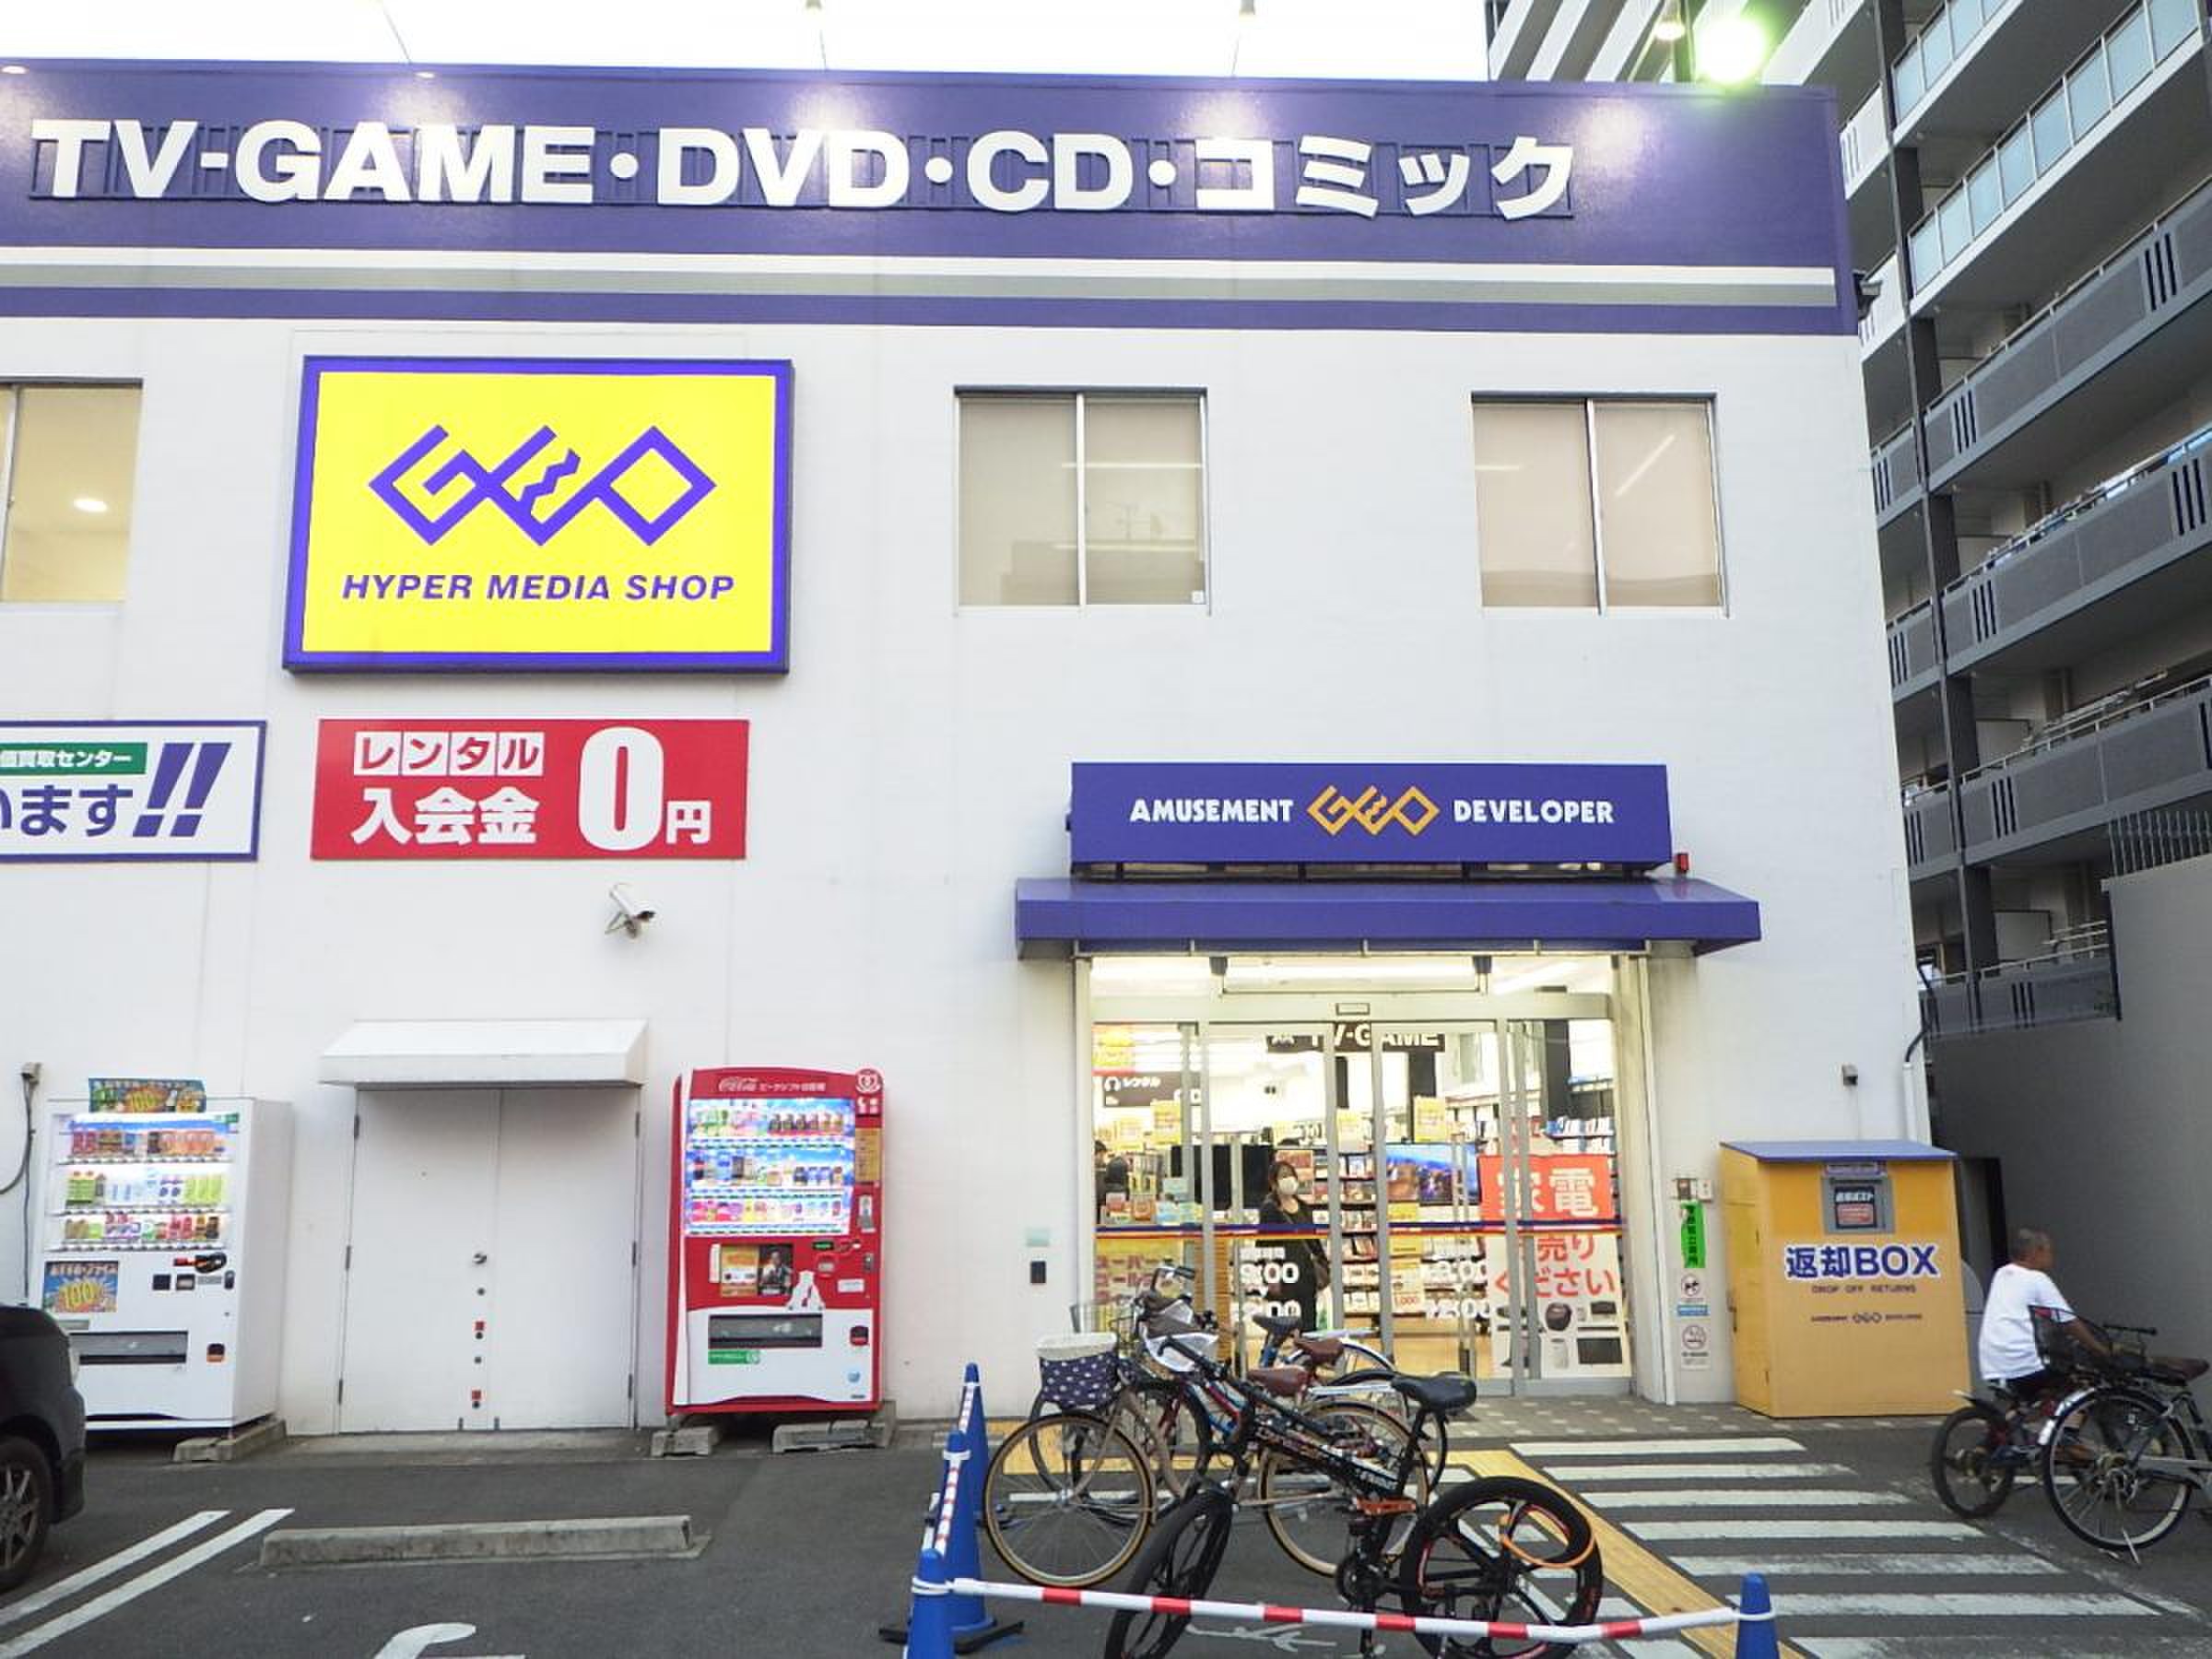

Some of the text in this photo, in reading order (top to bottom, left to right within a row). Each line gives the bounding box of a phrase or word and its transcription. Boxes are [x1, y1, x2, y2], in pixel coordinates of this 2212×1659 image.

[30, 119, 1573, 221] TV-GAME DVD CD コミック
[369, 425, 717, 547] GEO
[342, 574, 735, 600] HYPER MEDIA SHOP
[359, 735, 540, 773] レンタル
[351, 786, 540, 845] 入会金
[1129, 784, 1615, 836] AMUSEMENT GEO DEVELOPER
[1786, 1244, 1938, 1278] 返却BOX
